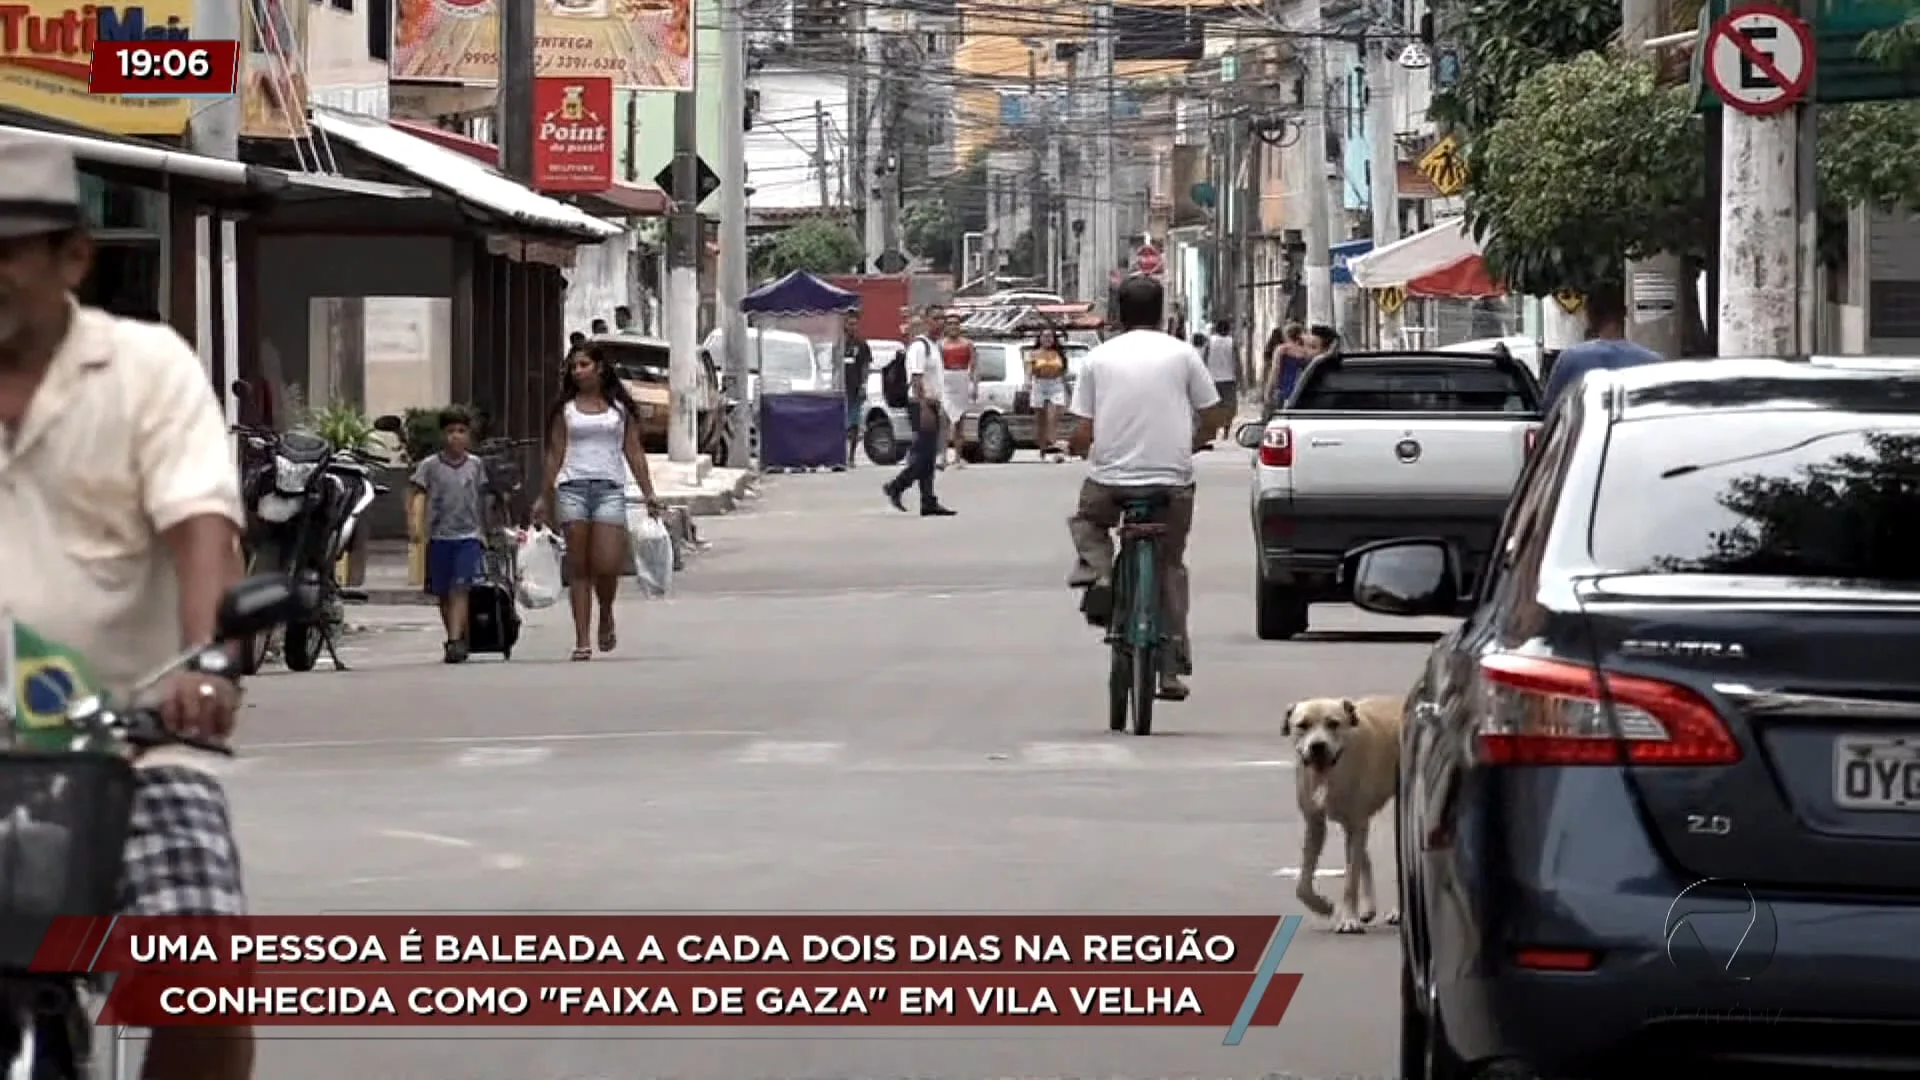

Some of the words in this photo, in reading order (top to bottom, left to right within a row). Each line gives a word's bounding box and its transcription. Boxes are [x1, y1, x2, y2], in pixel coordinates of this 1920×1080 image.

[1740, 27, 1777, 88] E
[539, 122, 606, 141] Point
[1620, 639, 1745, 657] SENTRA
[1687, 814, 1731, 835] 2.0
